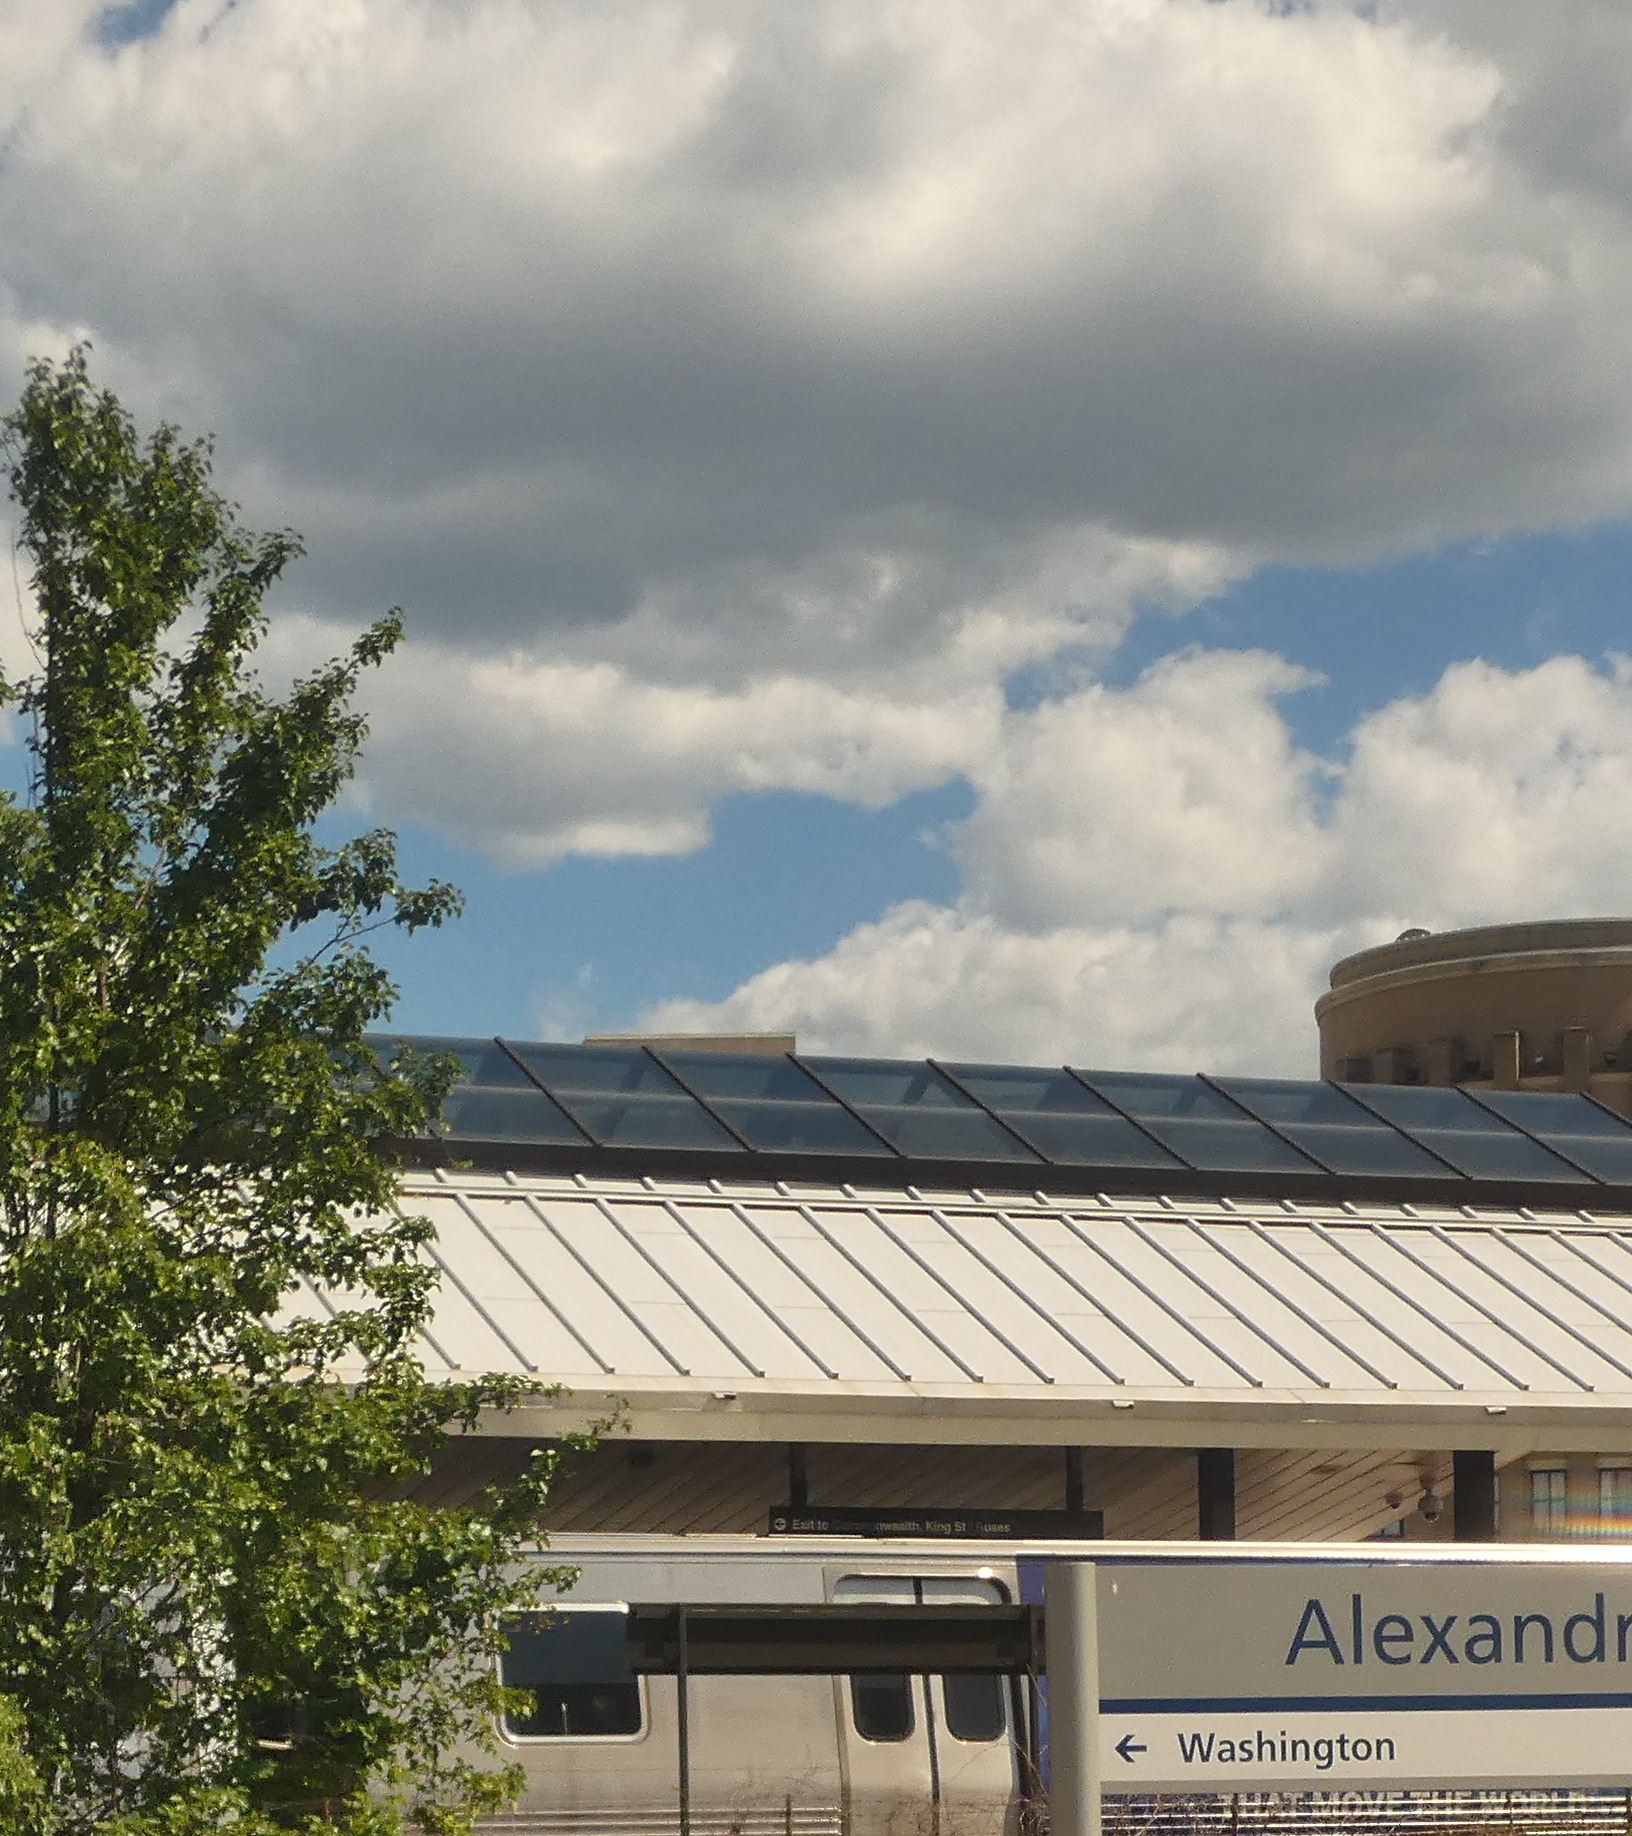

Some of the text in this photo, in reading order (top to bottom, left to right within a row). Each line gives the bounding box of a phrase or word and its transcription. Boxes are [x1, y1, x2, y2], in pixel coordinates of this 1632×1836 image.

[791, 1519, 813, 1531] Exit
[816, 1519, 829, 1531] to
[925, 1521, 952, 1534] King
[954, 1521, 967, 1532] St
[1176, 1729, 1397, 1769] Washington
